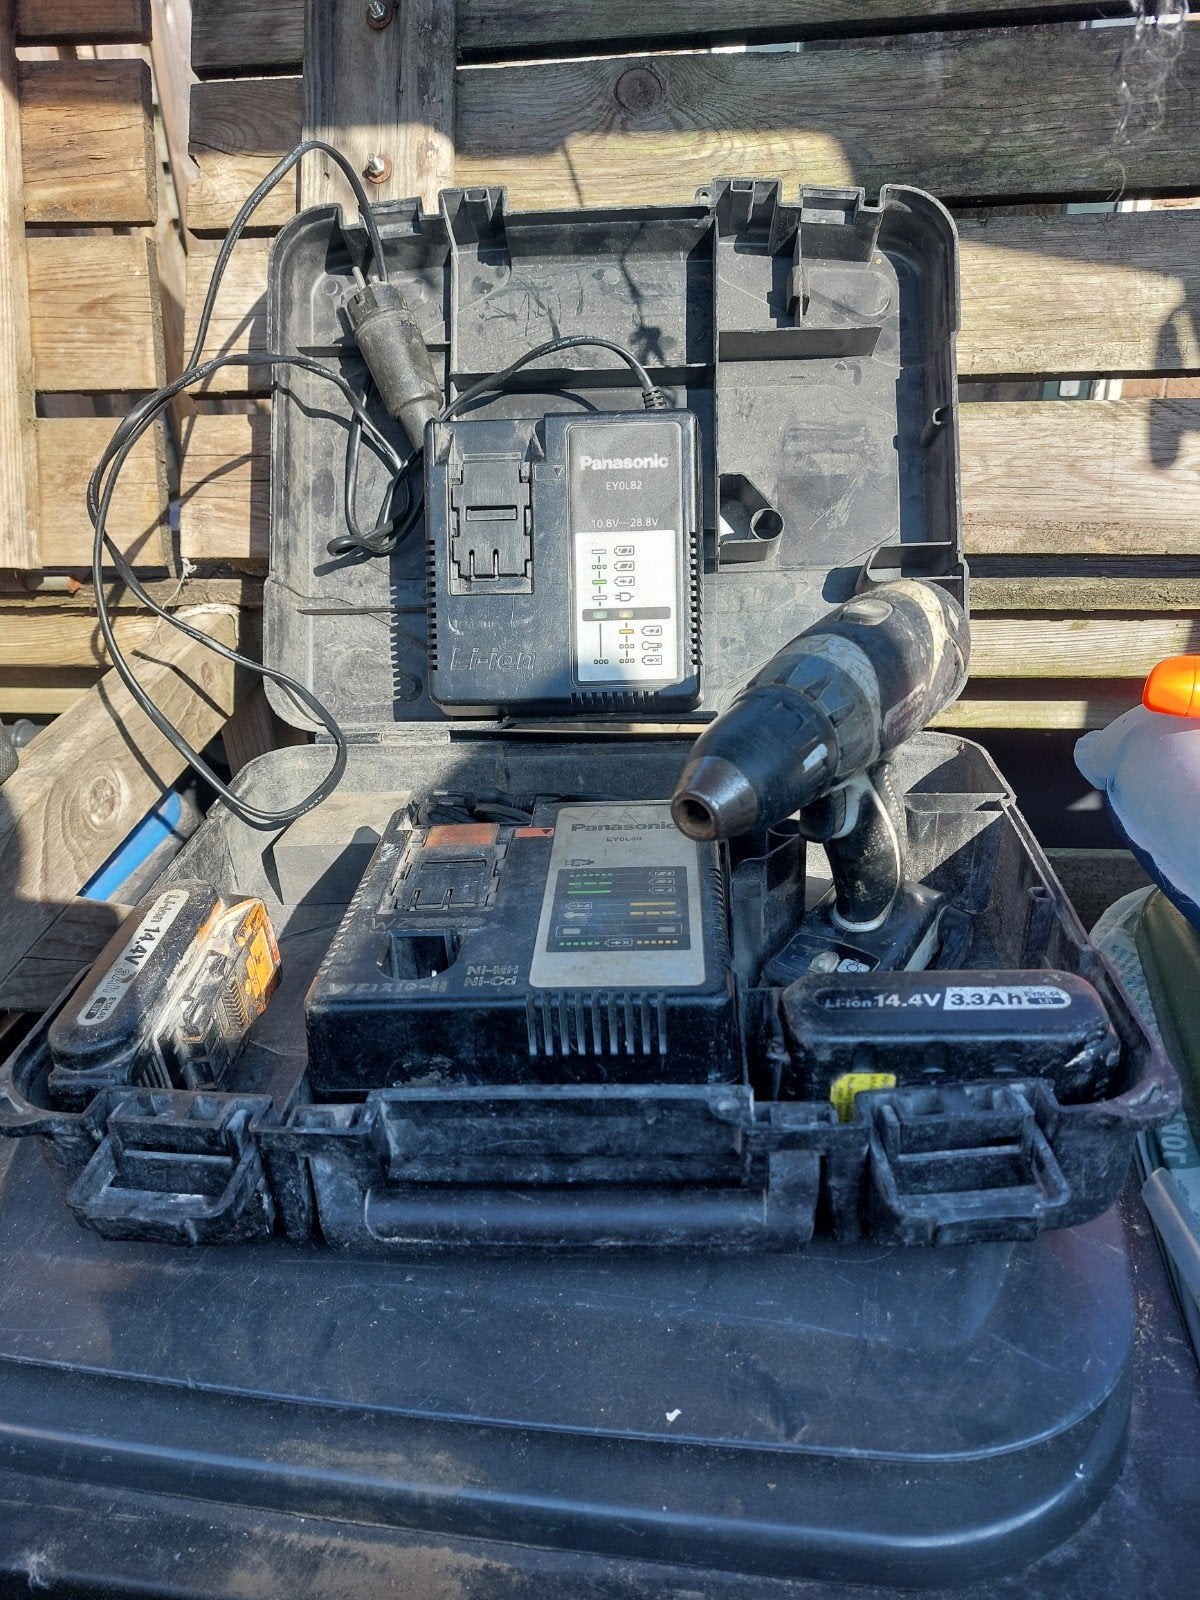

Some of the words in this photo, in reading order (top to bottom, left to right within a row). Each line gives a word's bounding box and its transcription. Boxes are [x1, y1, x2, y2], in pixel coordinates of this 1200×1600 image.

[580, 453, 669, 471] Panasonic
[606, 480, 642, 490] EY0L82
[450, 647, 536, 670] Li-ion
[571, 821, 678, 831] Panasonic
[124, 927, 160, 966] 14.4V
[466, 964, 520, 975] Ni-MH
[463, 976, 518, 986] Ni-Cd
[824, 995, 872, 1008] Li-ion
[873, 993, 942, 1008] 14.4V
[950, 993, 1023, 1006] 3.3Ah
